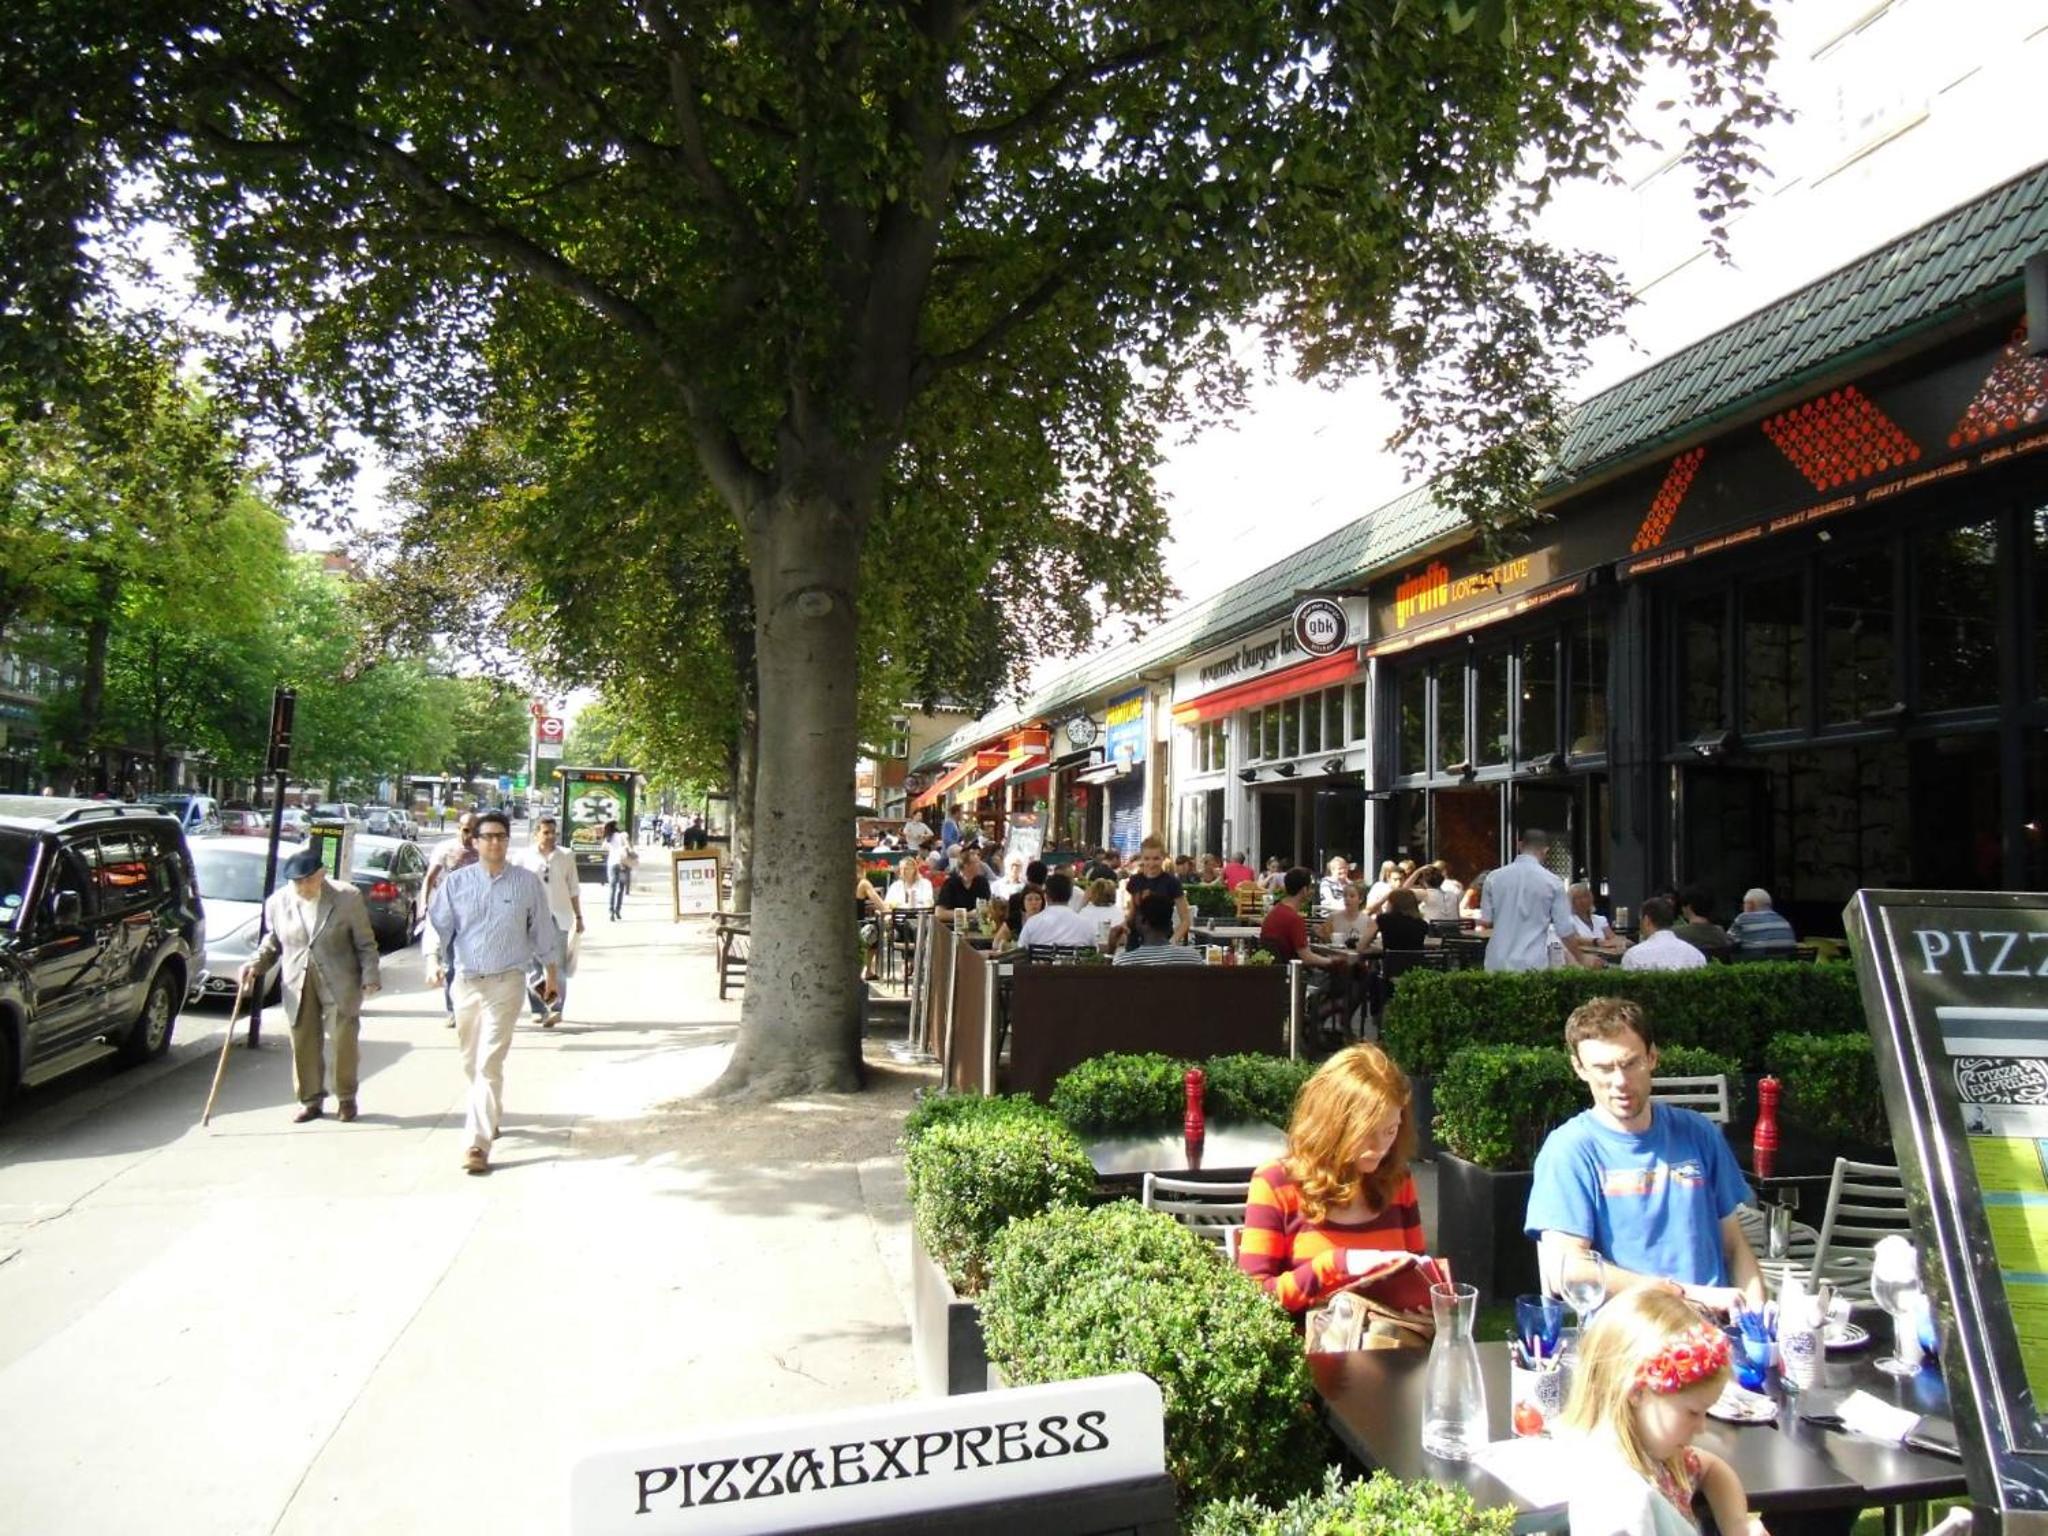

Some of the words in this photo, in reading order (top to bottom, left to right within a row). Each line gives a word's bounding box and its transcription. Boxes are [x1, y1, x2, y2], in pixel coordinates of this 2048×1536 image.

[1451, 576, 1479, 602] LOVE
[1503, 558, 1529, 584] LIVE
[1309, 618, 1334, 636] gbk
[1242, 643, 1279, 671] burger
[1969, 1073, 2046, 1096] EXPRESS
[1977, 1064, 2027, 1083] PIZZA
[634, 1409, 1110, 1515] PIZZAEXPRESS
